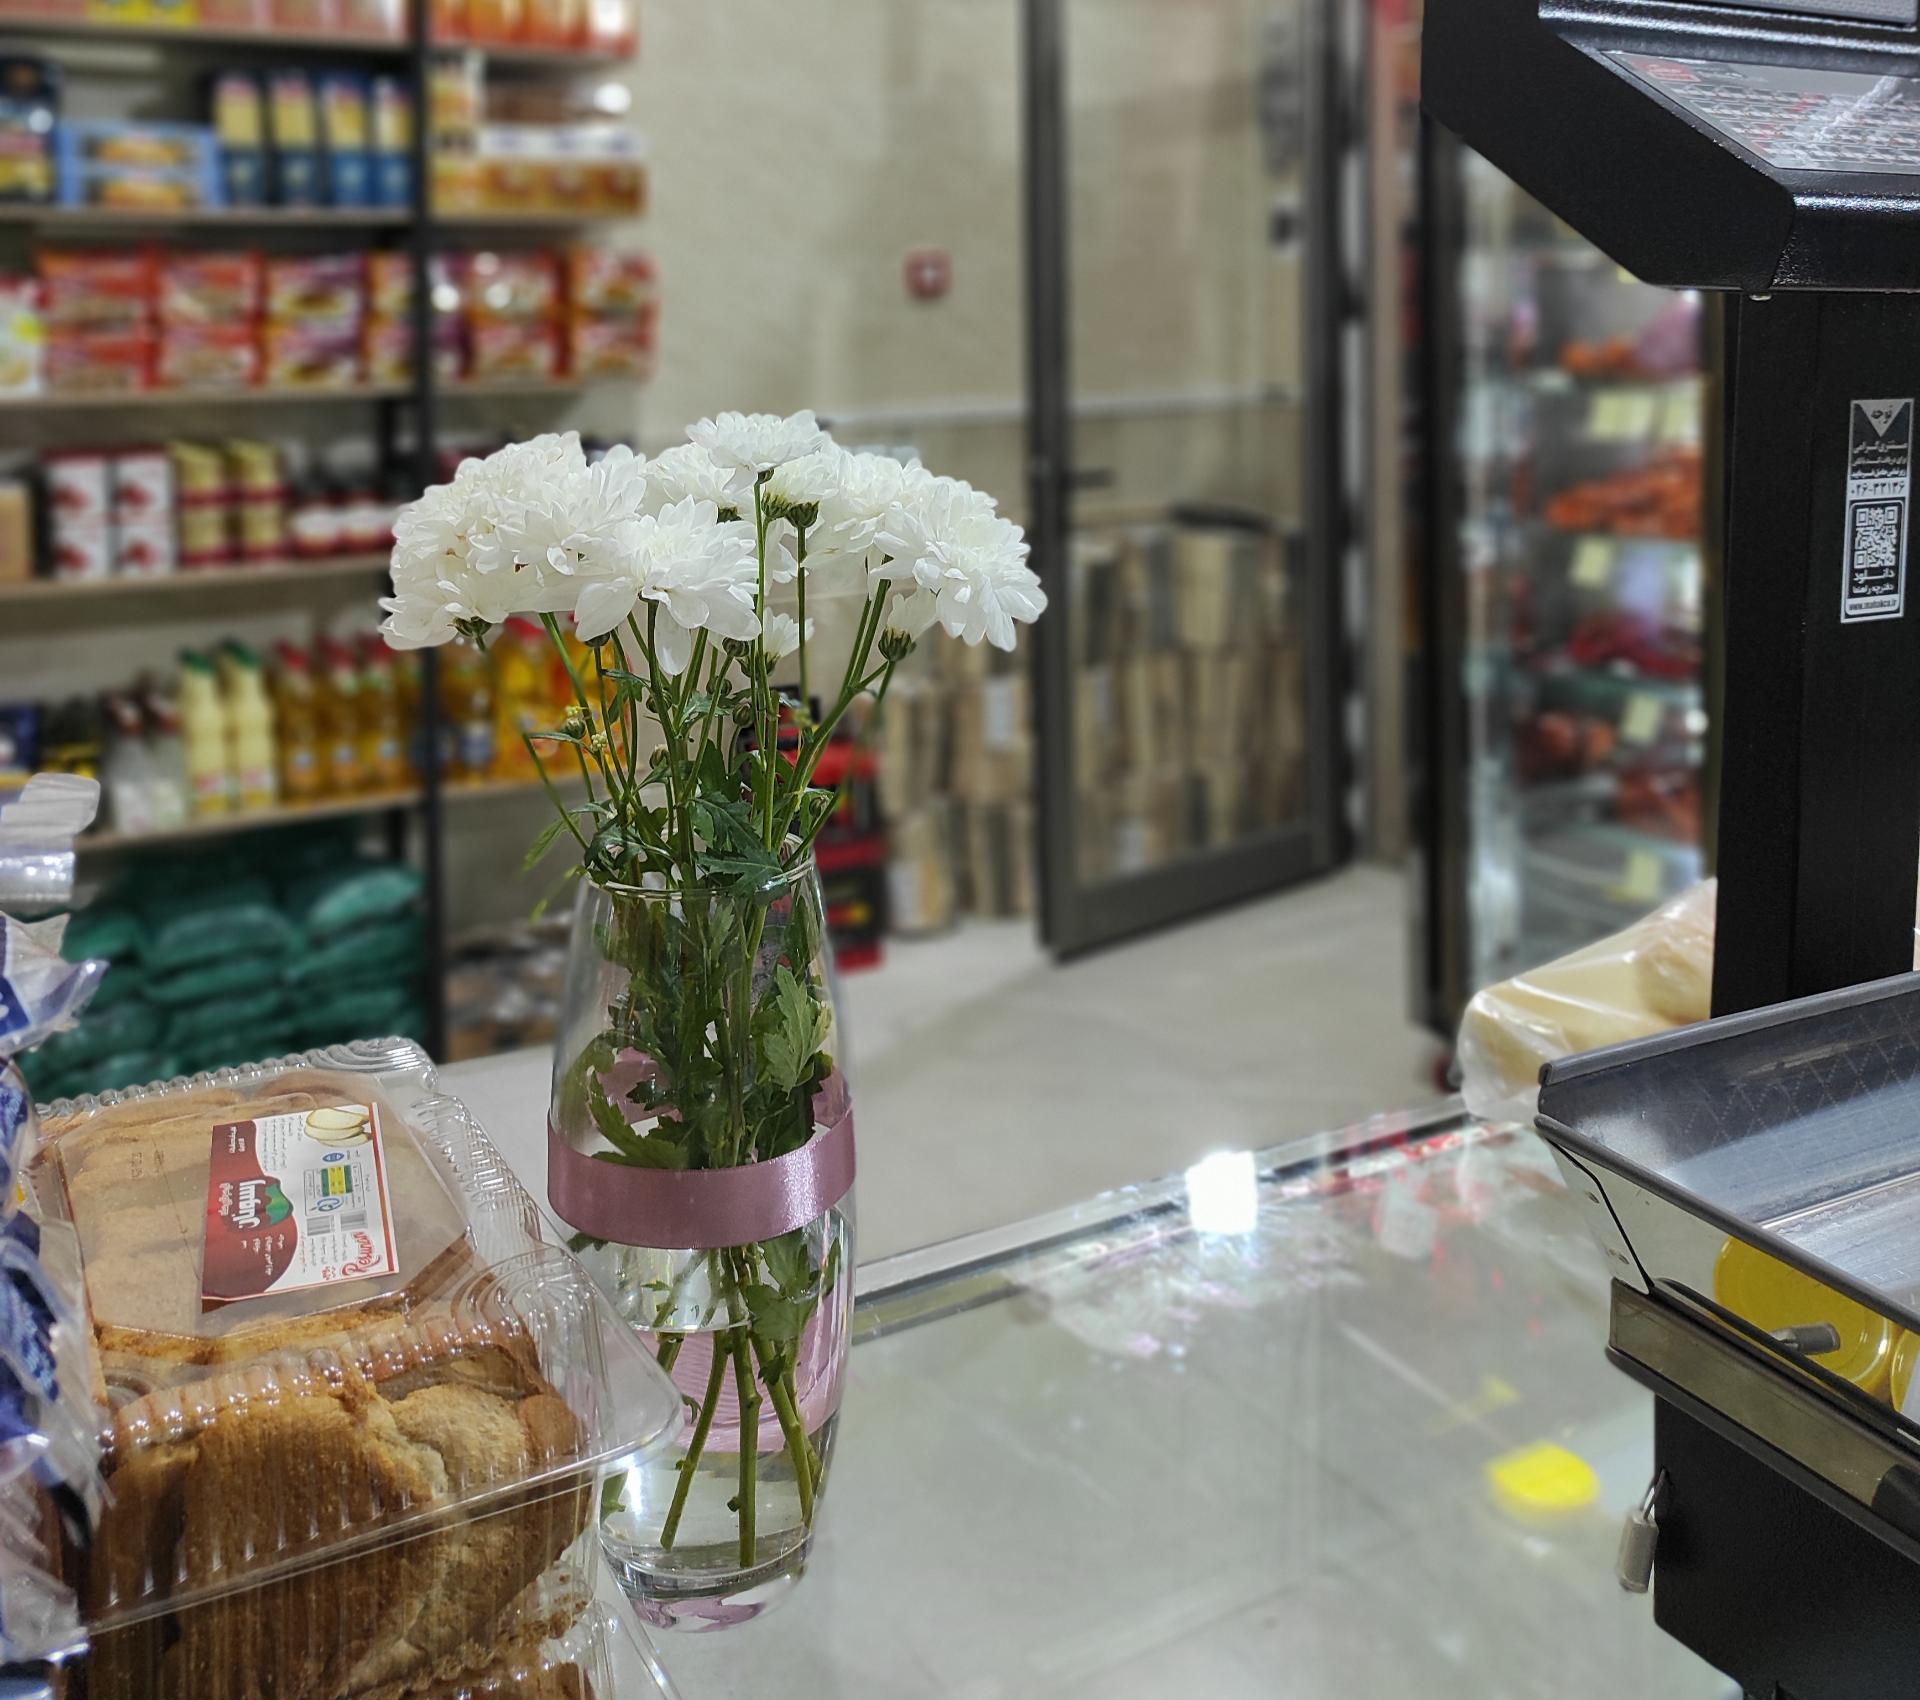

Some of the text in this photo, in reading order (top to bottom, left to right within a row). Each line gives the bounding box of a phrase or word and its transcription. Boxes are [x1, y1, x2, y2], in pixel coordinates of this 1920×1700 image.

[1870, 404, 1893, 424] توجه
[1853, 568, 1895, 584] دانلود
[1852, 583, 1894, 595] دفترچه راهنما
